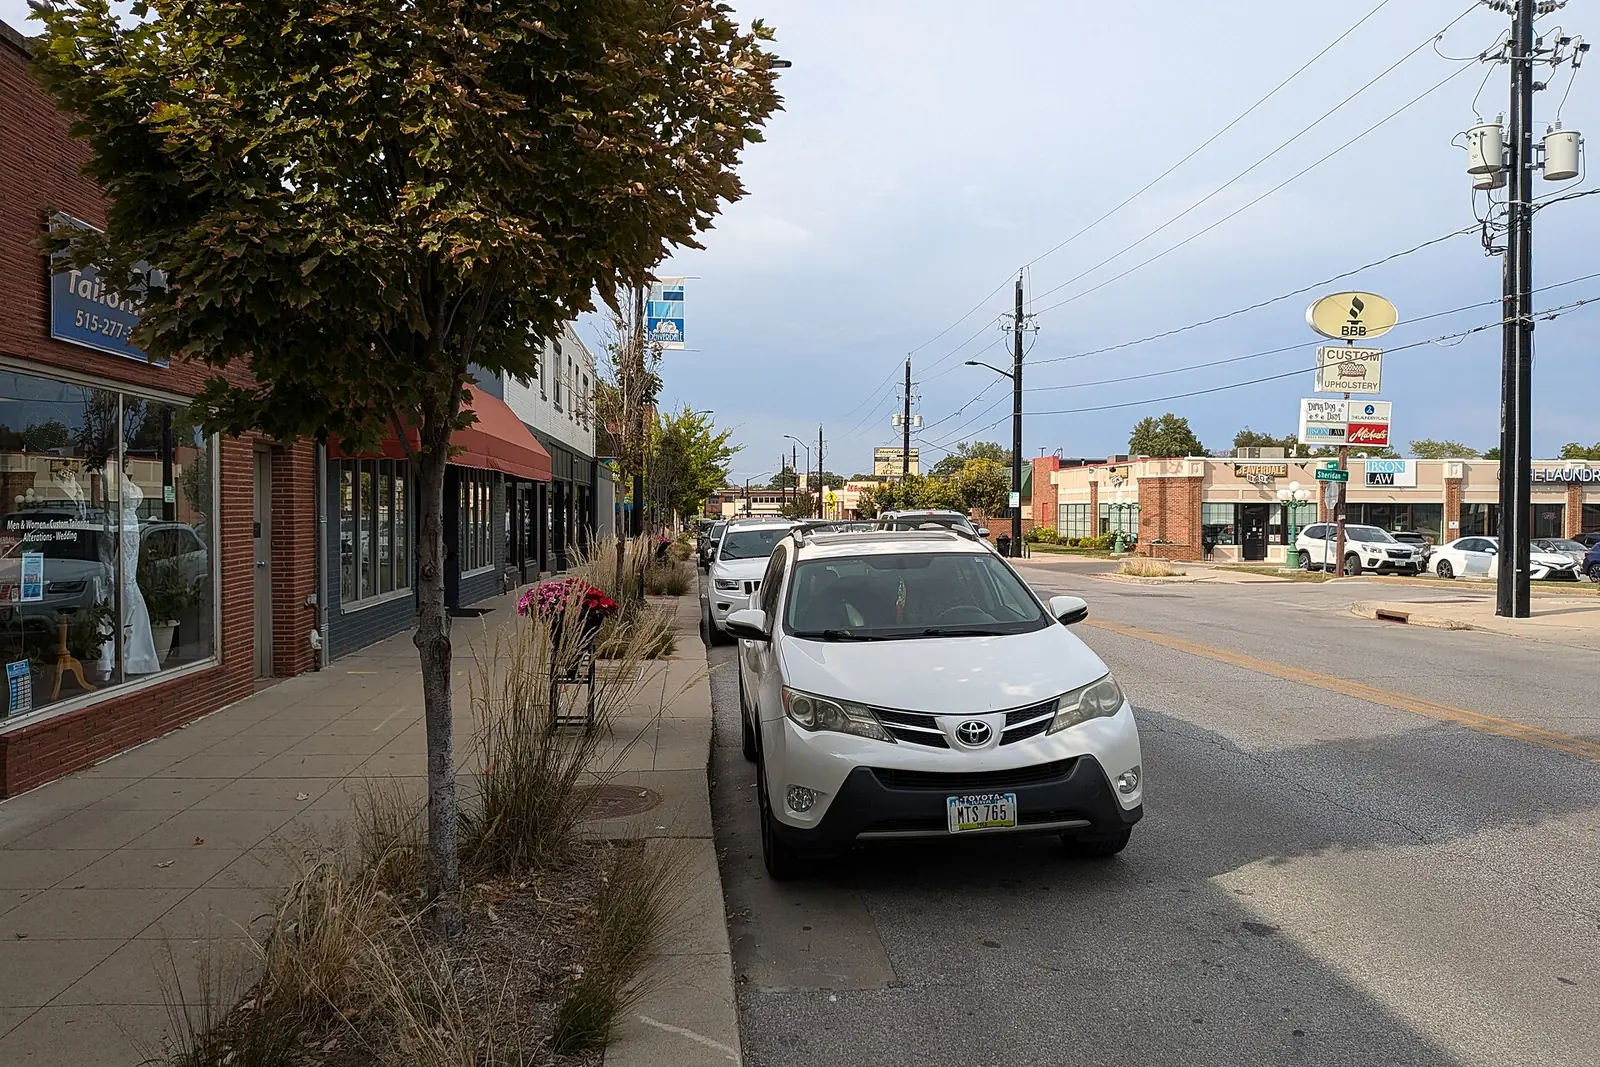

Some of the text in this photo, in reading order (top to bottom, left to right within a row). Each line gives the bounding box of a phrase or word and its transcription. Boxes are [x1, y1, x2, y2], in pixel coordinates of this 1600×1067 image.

[1341, 326, 1367, 336] BBB
[1327, 349, 1380, 362] CUSTOM
[1324, 380, 1378, 390] UPHOLSTERY
[1329, 428, 1345, 436] LAW
[1366, 461, 1405, 473] IBSON
[1317, 470, 1342, 480] Sheridan
[1366, 473, 1394, 485] LAW
[7, 520, 20, 530] Men
[20, 520, 26, 530] &
[26, 520, 46, 530] Women
[50, 519, 69, 529] Custom
[23, 532, 53, 542] Alterations
[56, 531, 78, 542] Wedding
[962, 793, 1000, 802] TOYOTA
[957, 804, 1007, 824] MTS 765
